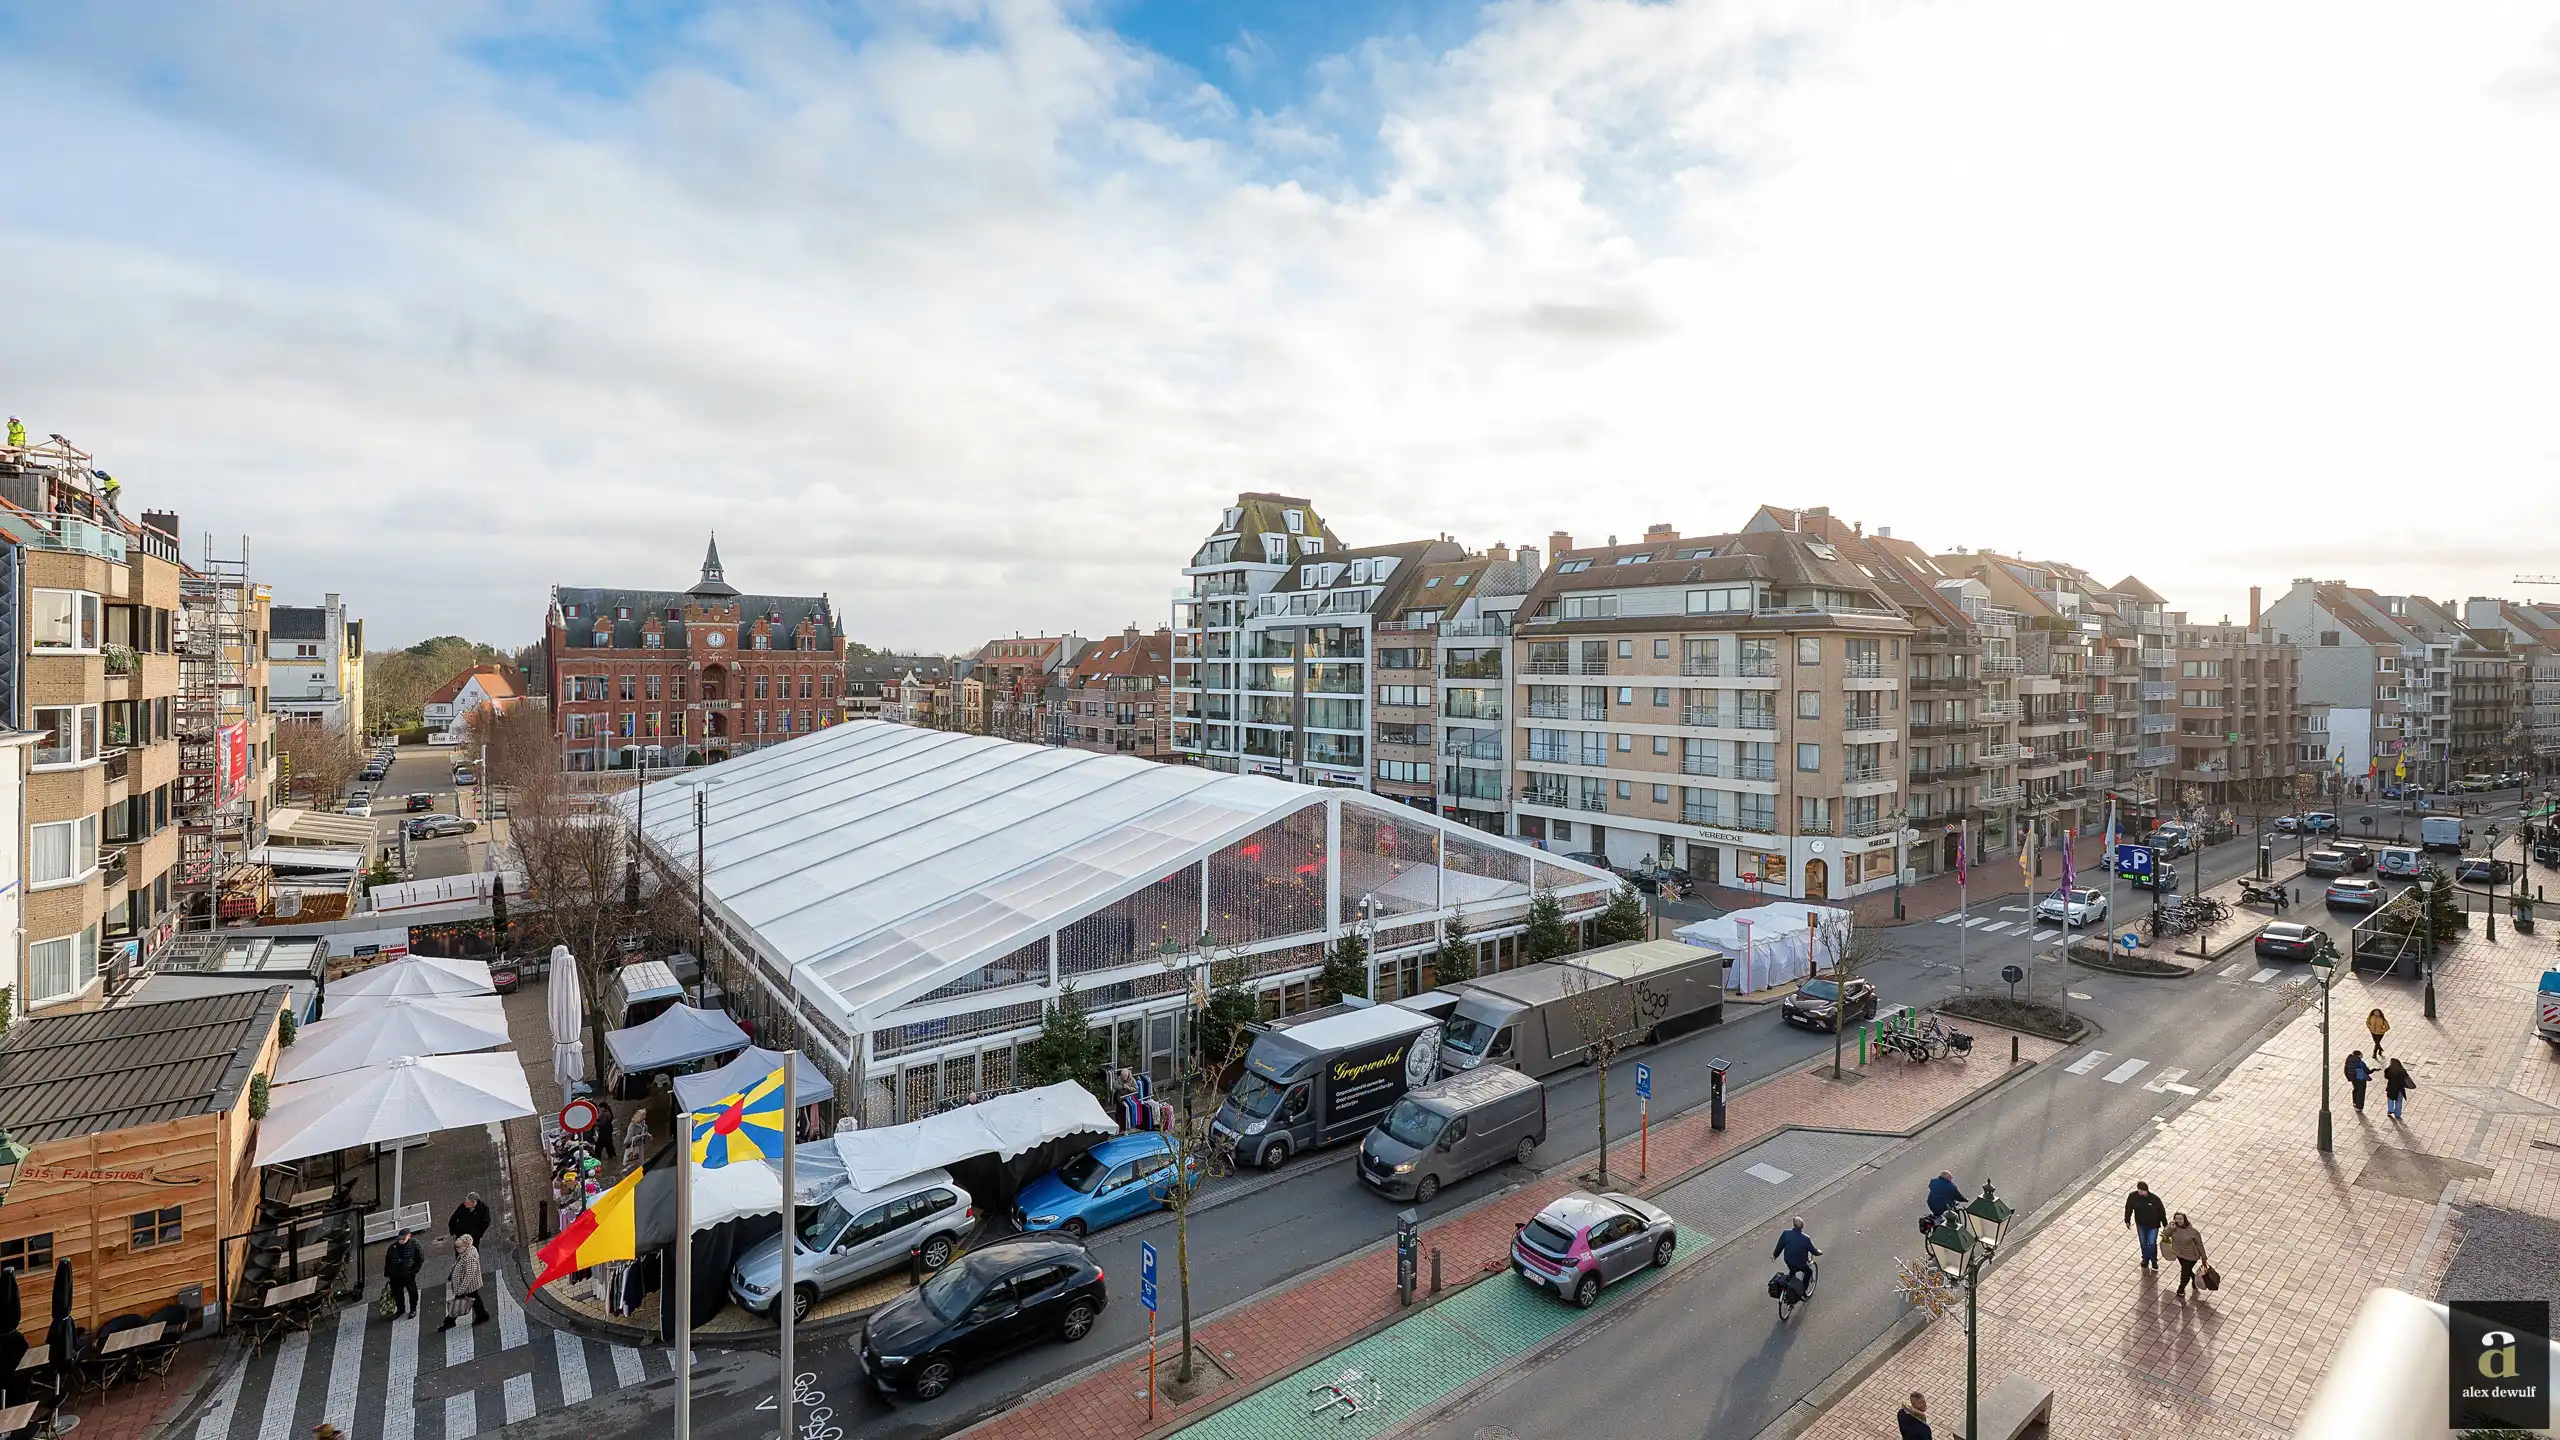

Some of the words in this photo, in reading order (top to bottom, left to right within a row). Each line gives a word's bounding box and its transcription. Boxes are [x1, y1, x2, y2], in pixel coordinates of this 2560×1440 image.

[1699, 830, 1744, 842] VEREECKE
[2133, 852, 2148, 870] P
[1333, 1046, 1404, 1081] Gregowatch
[1637, 1067, 1649, 1084] P
[1143, 1247, 1154, 1274] P
